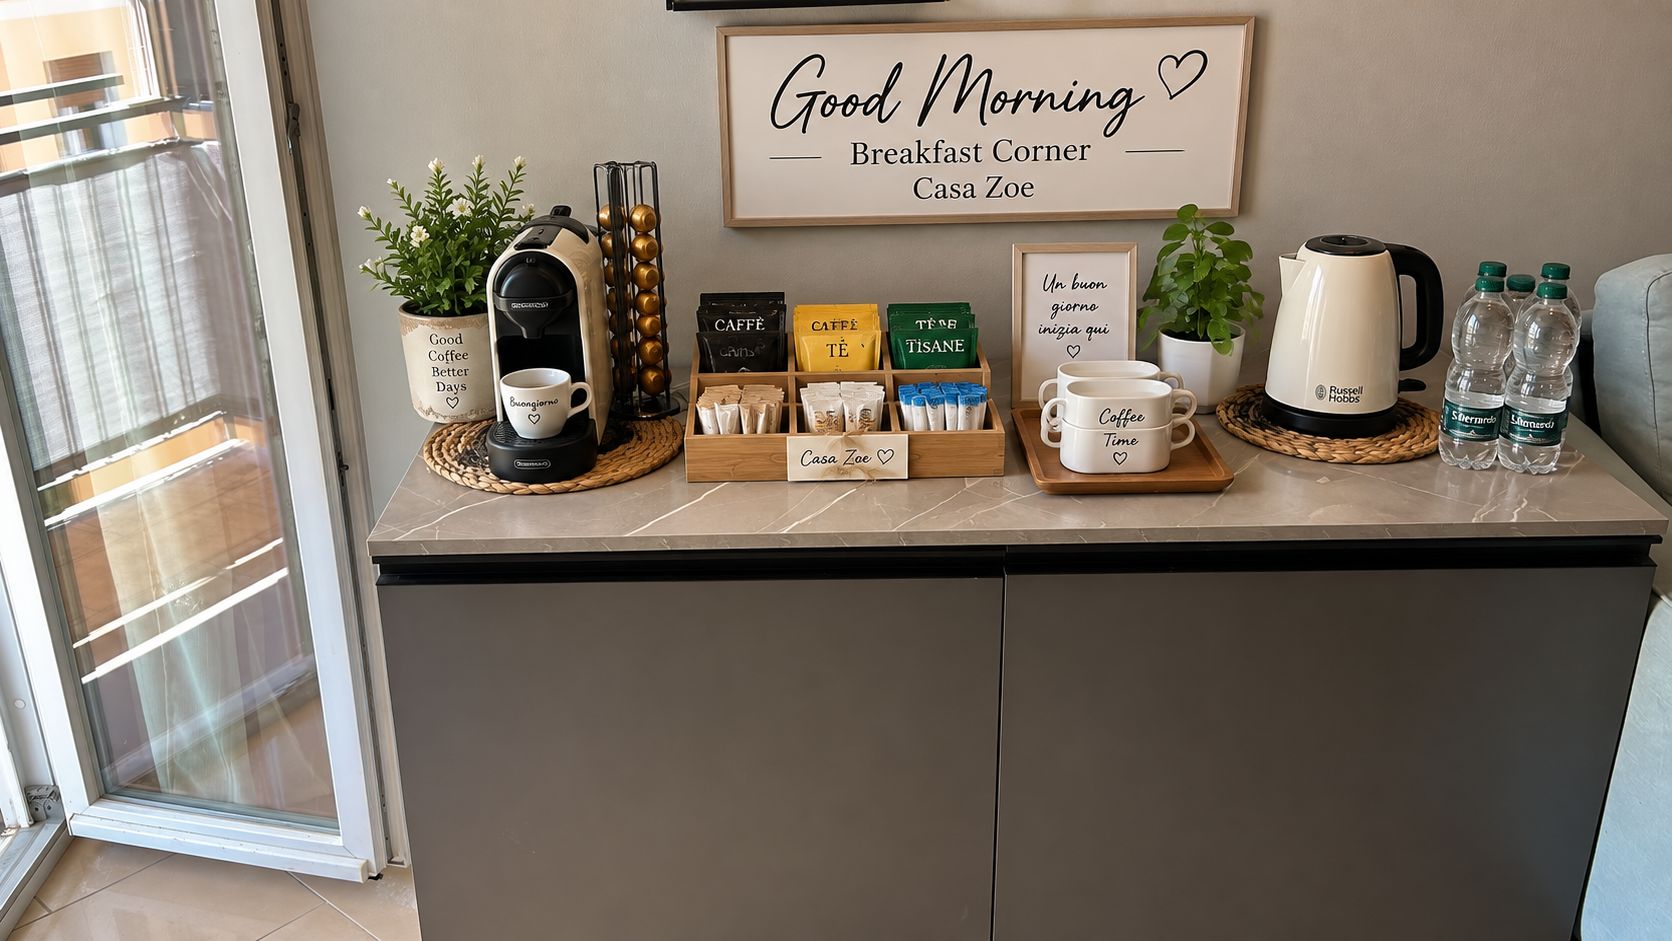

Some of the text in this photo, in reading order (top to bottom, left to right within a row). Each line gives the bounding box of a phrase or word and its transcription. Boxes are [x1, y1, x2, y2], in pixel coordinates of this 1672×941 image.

[770, 53, 1146, 138] Good Morning
[850, 138, 1092, 165] Breakfast Corner
[913, 175, 1035, 200] Casa Zoe
[1042, 272, 1108, 293] Un buon
[1050, 301, 1099, 320] giorno
[429, 332, 464, 346] Good
[1038, 323, 1110, 342] inizia qui
[428, 349, 469, 364] Coffee
[431, 366, 470, 377] Better
[436, 381, 467, 395] Days
[1329, 385, 1364, 395] Russell
[509, 395, 559, 412] Buongiorno
[1328, 394, 1360, 403] Hobbs
[1098, 407, 1146, 429] Coffee
[1103, 432, 1139, 448] Time
[800, 448, 872, 467] Casa Zoe
